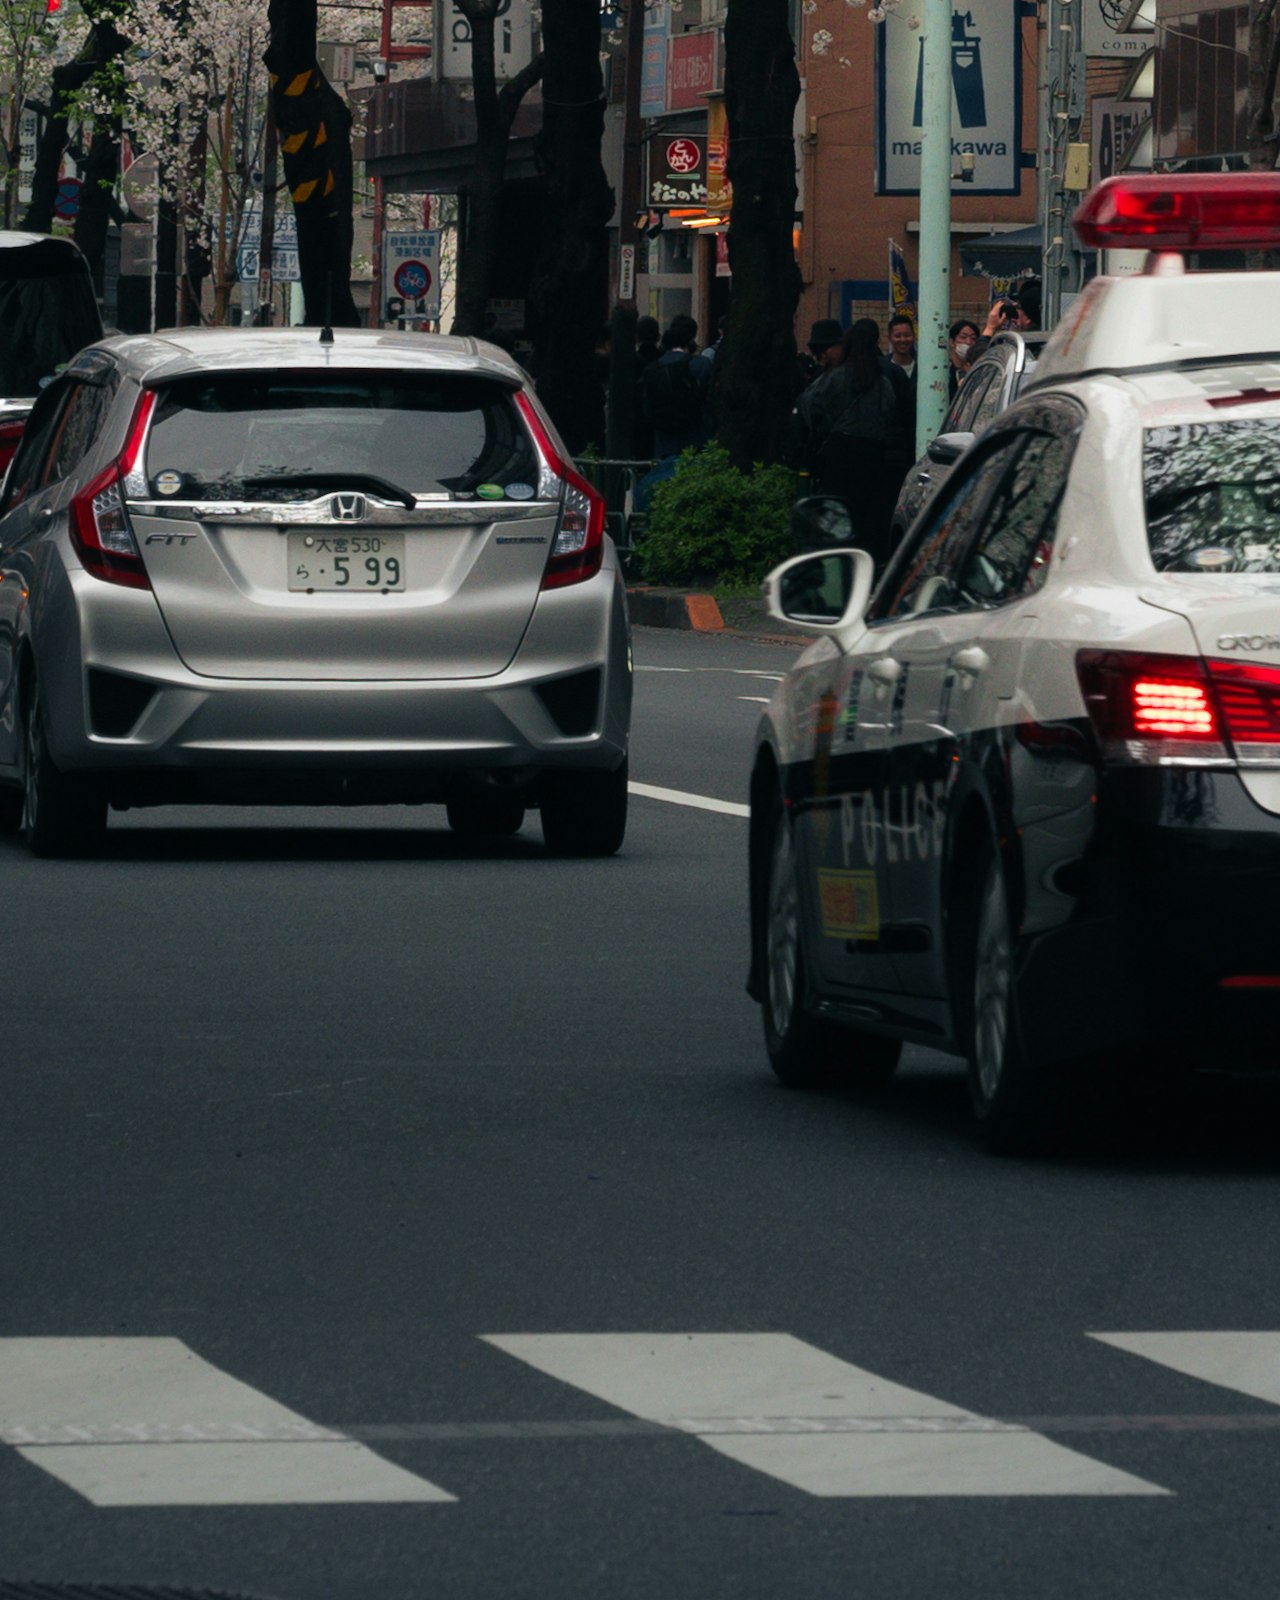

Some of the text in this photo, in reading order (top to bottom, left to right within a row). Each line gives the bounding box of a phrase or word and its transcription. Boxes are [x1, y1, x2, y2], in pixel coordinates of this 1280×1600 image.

[1102, 39, 1147, 50] coma
[892, 138, 1007, 156] makawa
[145, 531, 197, 546] FIT
[316, 537, 381, 553] 大宮 530
[296, 564, 310, 580] ら
